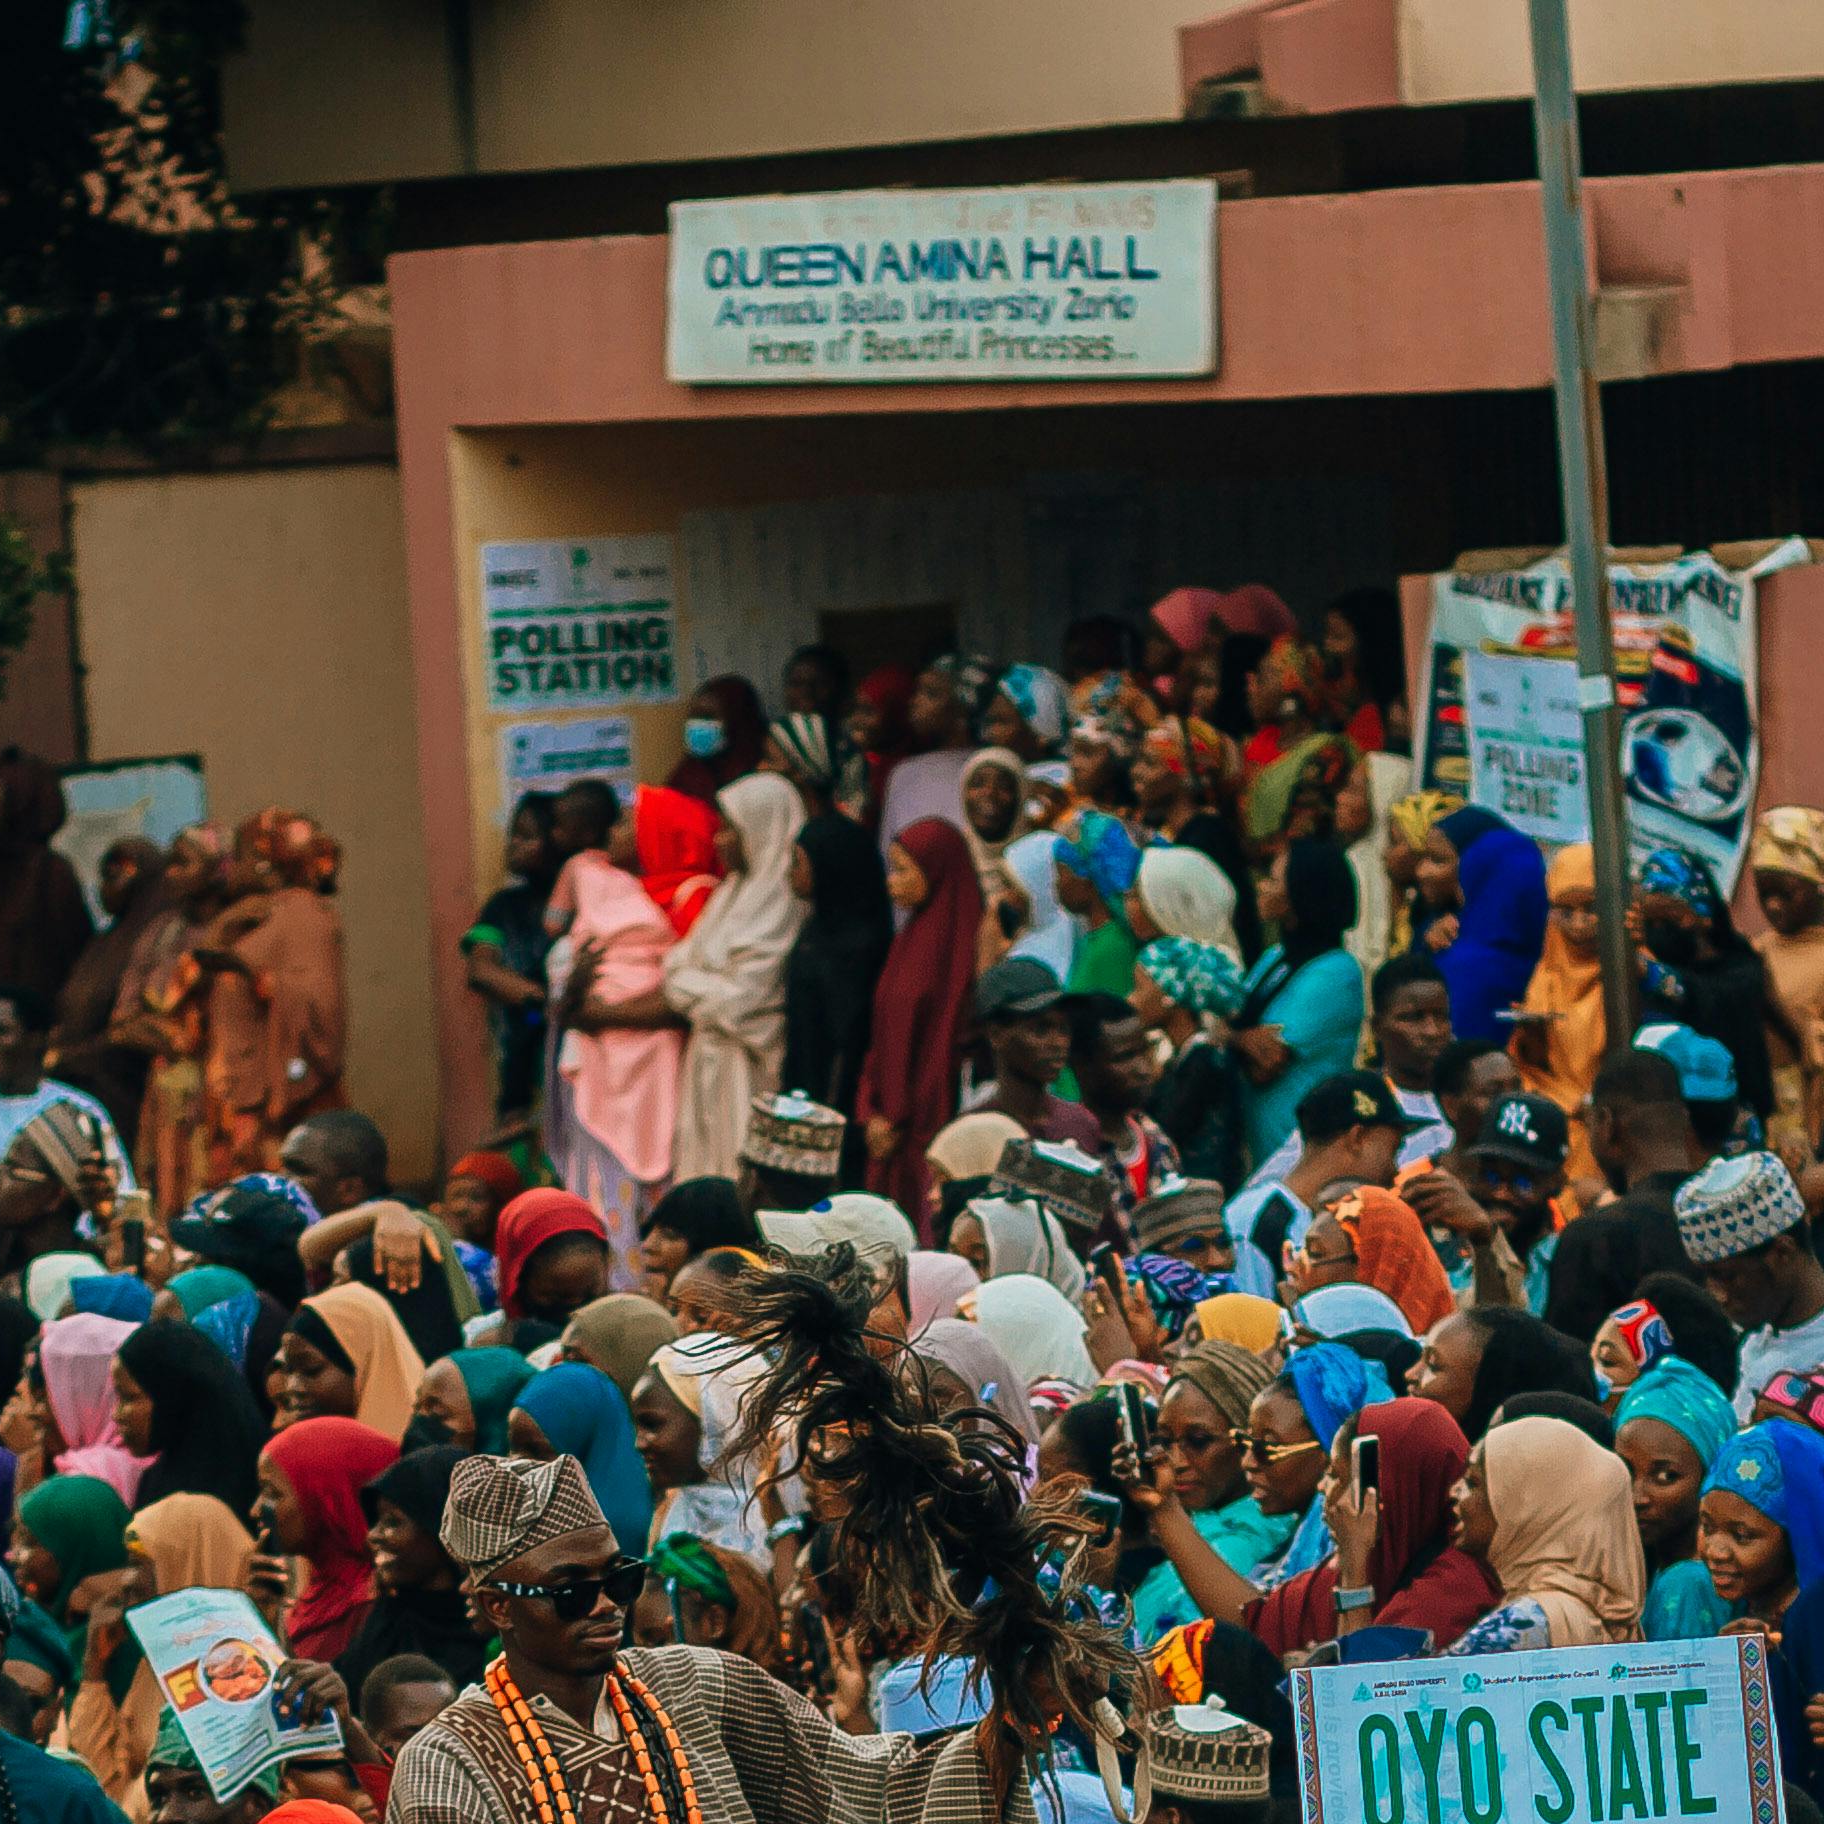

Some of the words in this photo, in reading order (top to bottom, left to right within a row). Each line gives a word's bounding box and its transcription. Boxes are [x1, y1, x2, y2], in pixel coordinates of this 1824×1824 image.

[704, 241, 868, 290] QUEEN
[872, 236, 1012, 282] AMINA
[1022, 234, 1160, 281] HALL
[748, 335, 814, 366] Home
[824, 330, 856, 364] of
[862, 327, 970, 363] Beautiful
[491, 617, 670, 658] POLLING
[495, 654, 673, 695] STATION
[1484, 745, 1581, 786] POLLING
[1502, 778, 1559, 820] ZONE
[1517, 1672, 1572, 1684] Representative
[1573, 1669, 1600, 1679] Council
